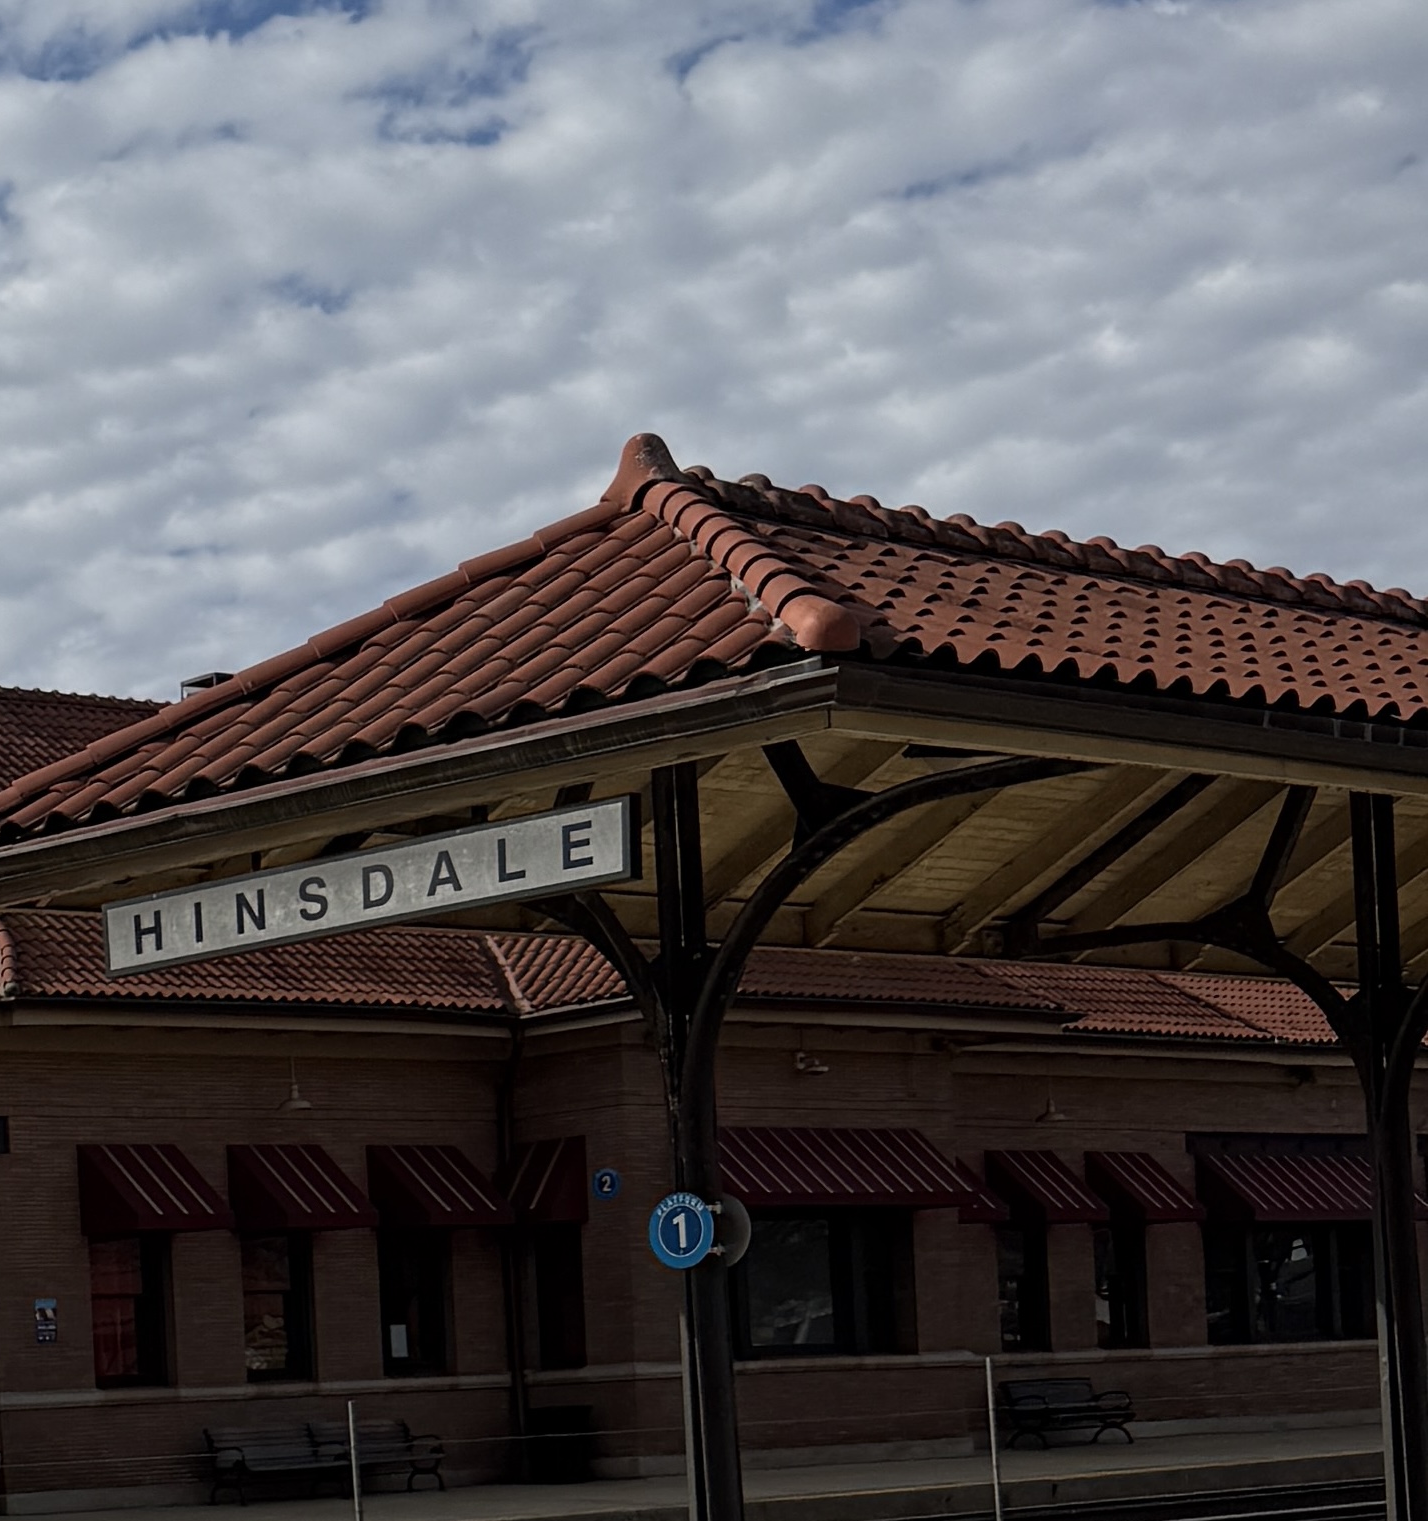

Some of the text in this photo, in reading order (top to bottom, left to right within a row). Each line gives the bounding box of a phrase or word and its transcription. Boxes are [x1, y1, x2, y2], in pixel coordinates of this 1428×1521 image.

[132, 819, 594, 955] HINSDALE
[601, 1175, 612, 1192] 2
[656, 1194, 705, 1216] PLATFORM
[672, 1212, 688, 1249] 1
